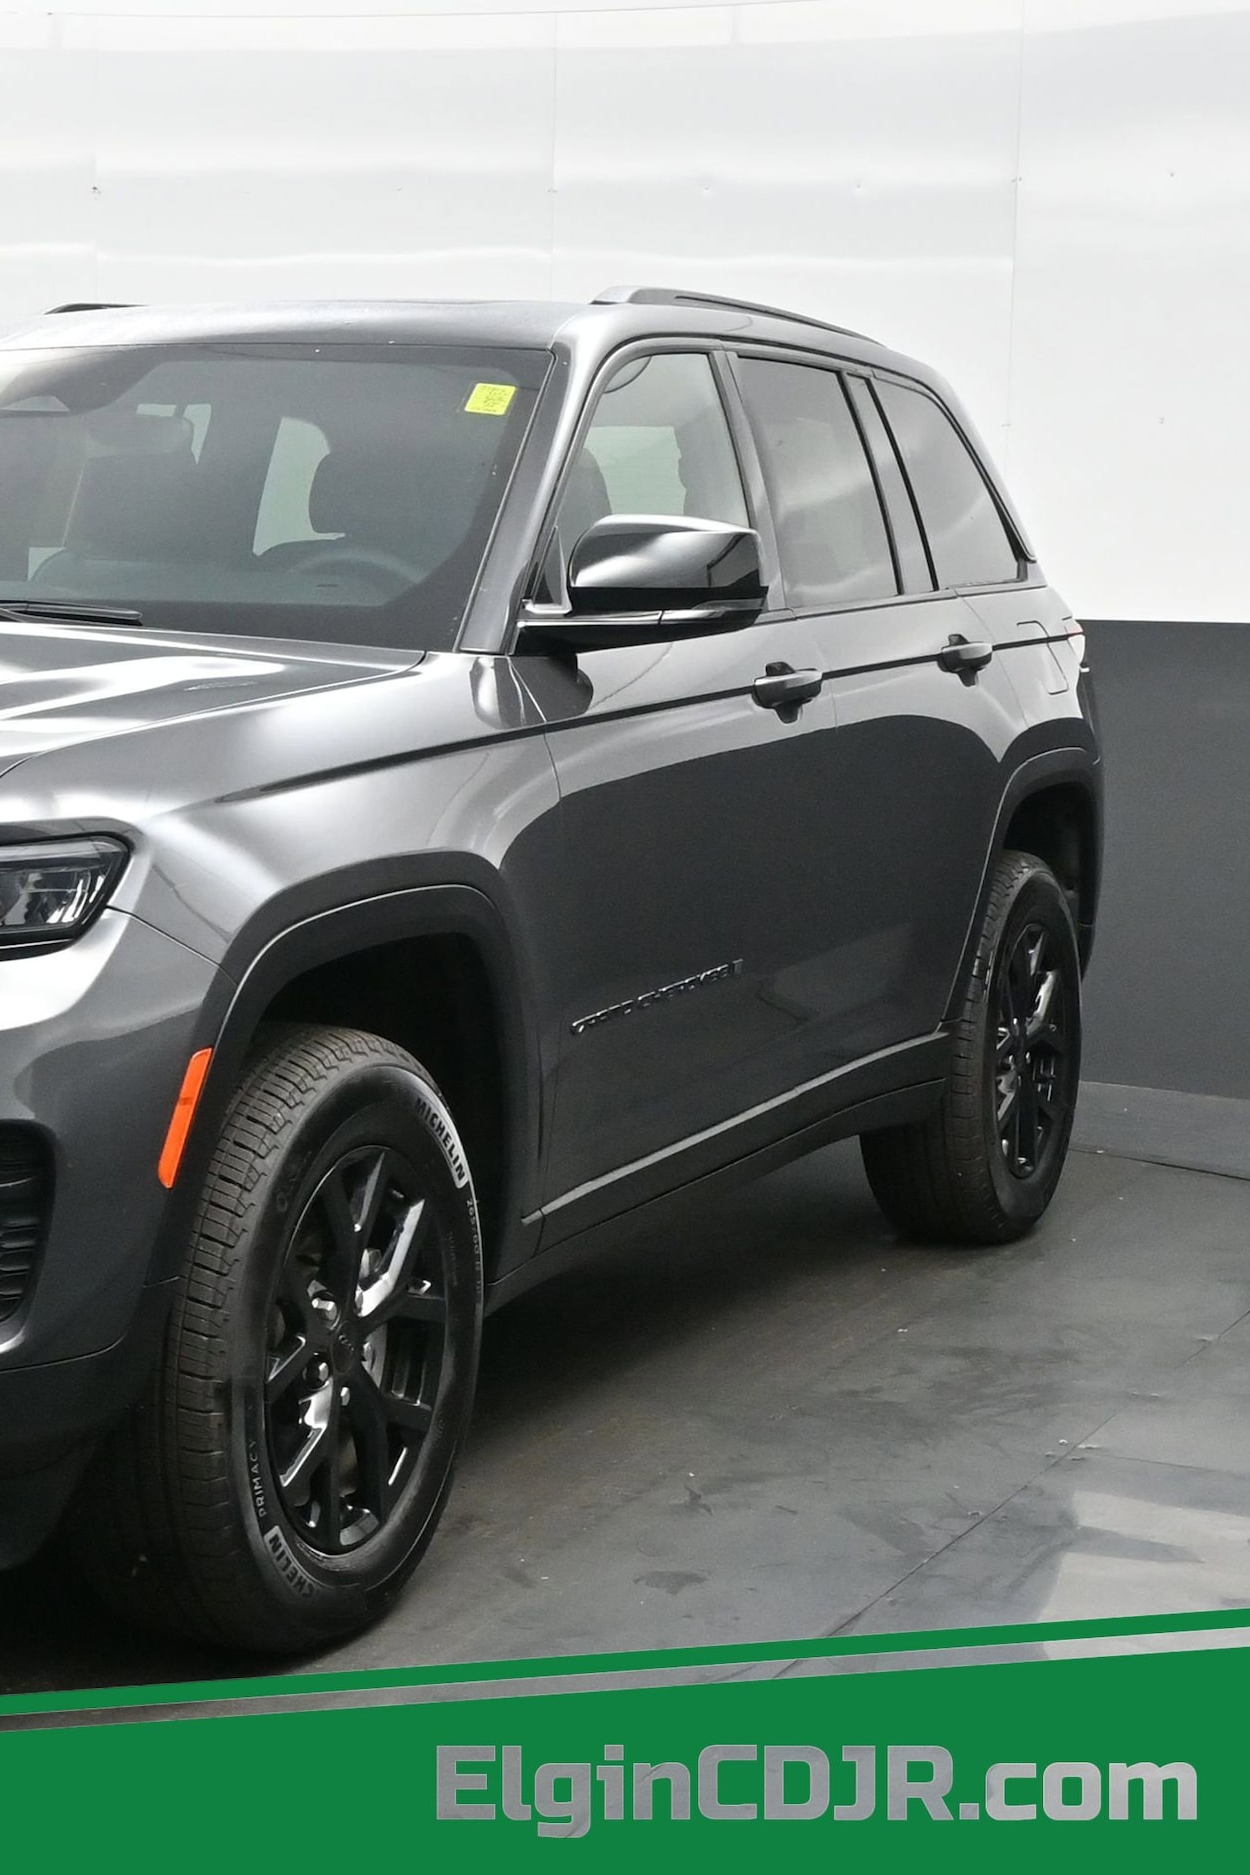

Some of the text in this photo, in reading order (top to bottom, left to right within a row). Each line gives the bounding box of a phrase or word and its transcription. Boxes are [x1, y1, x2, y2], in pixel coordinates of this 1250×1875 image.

[415, 1097, 466, 1181] MICHELIN
[247, 1440, 268, 1517] PRIMACY
[269, 1533, 318, 1597] CHELIN
